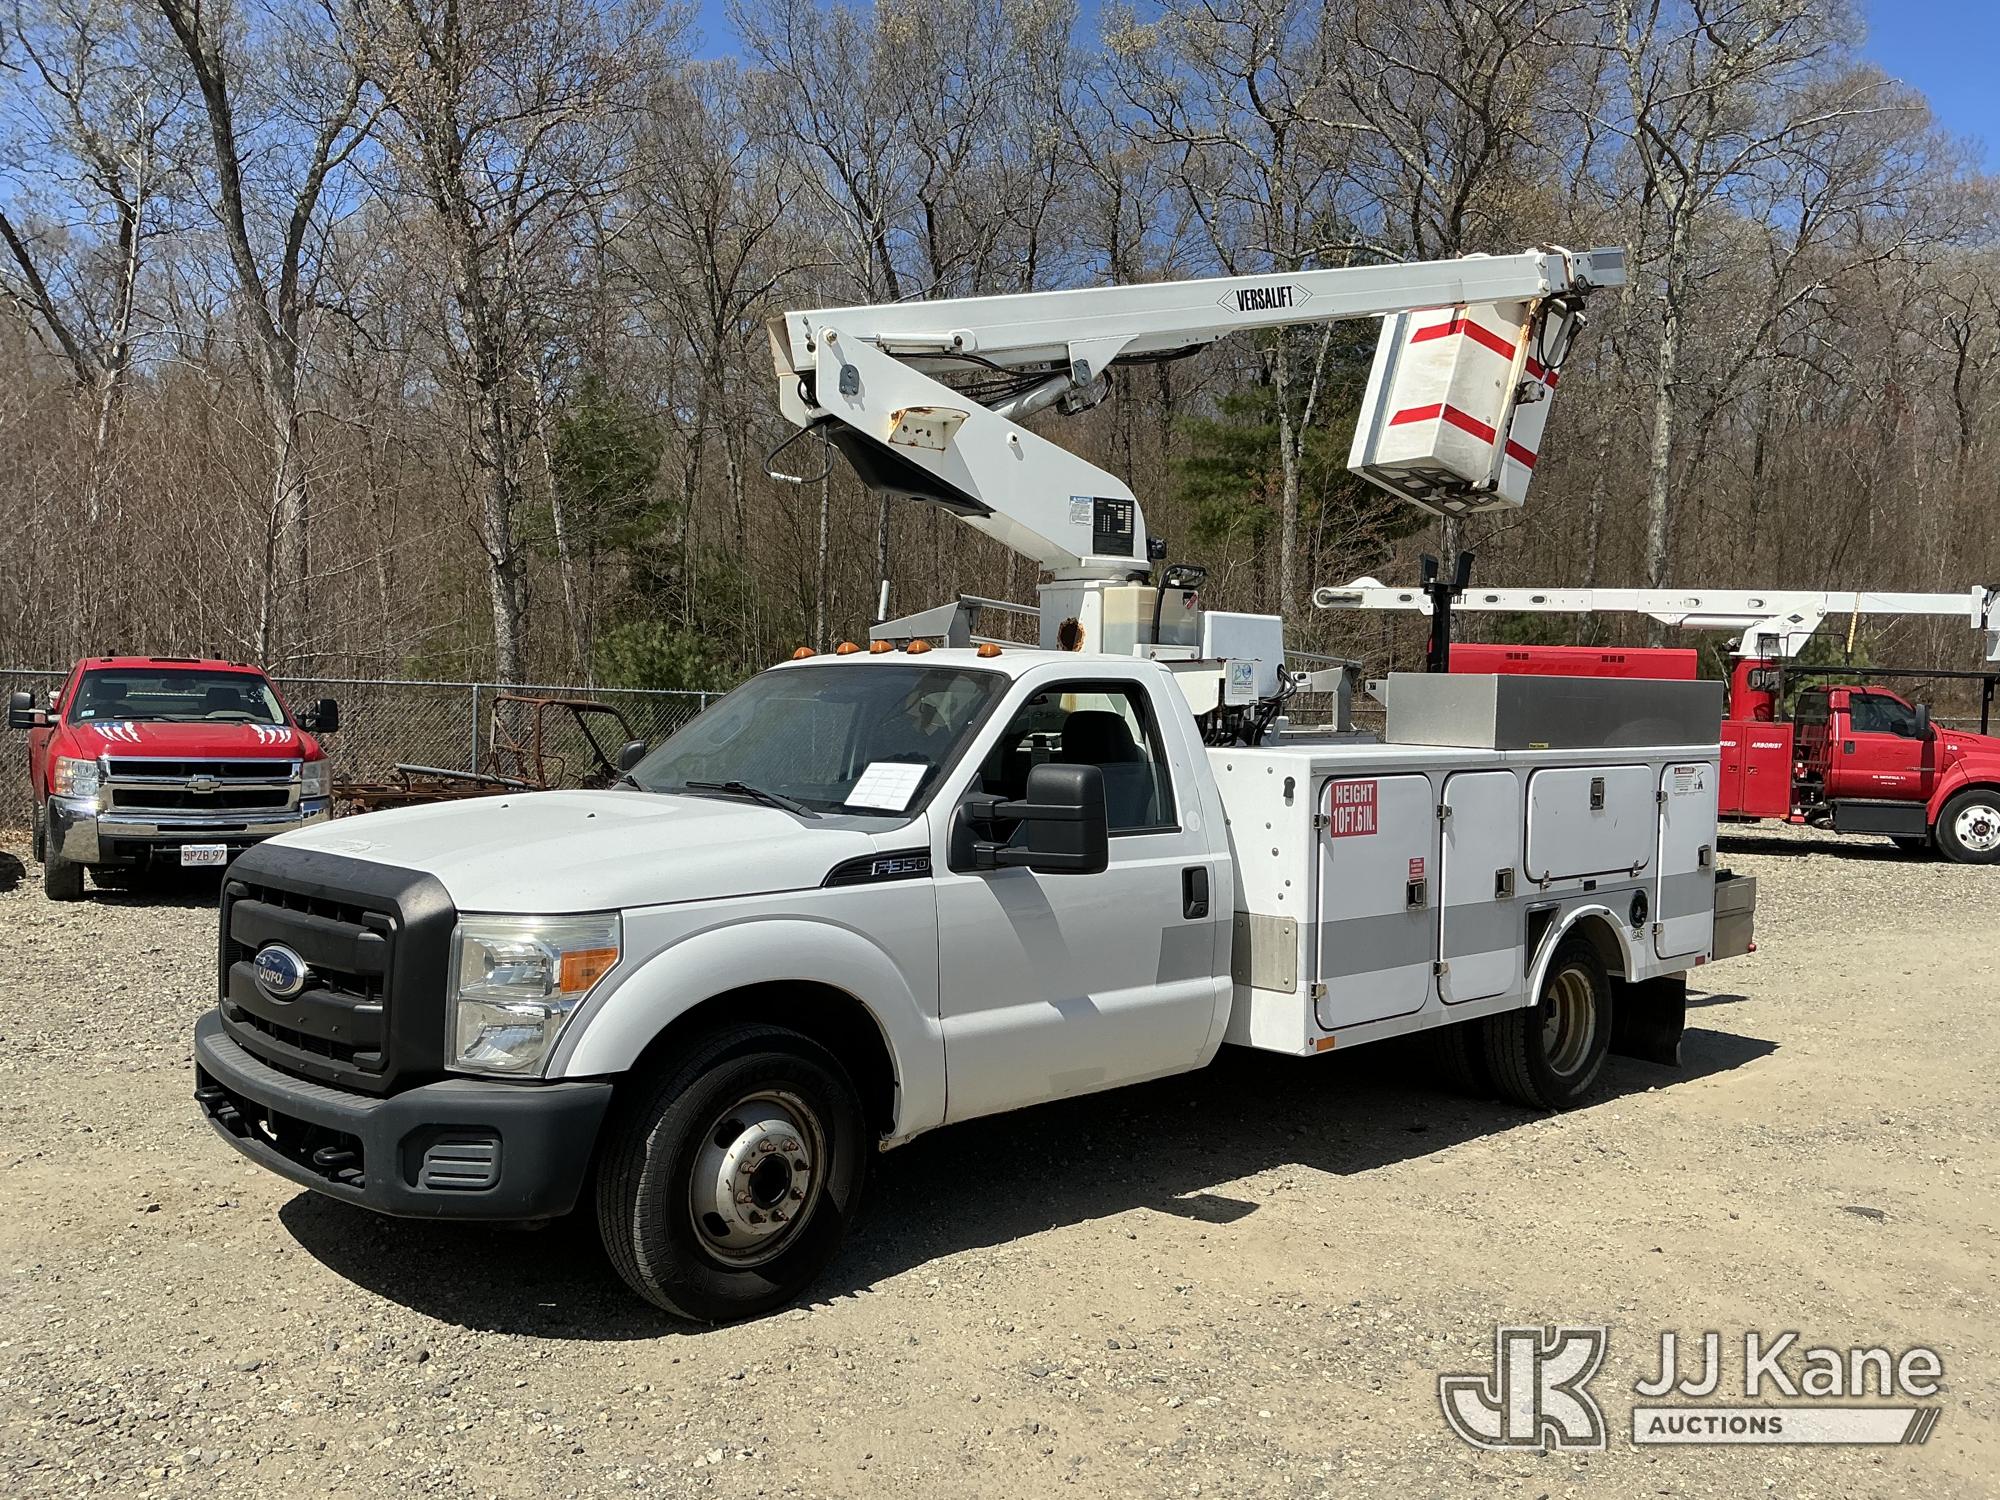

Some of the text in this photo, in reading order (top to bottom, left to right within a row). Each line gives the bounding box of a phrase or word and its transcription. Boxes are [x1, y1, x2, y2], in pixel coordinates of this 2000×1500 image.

[1236, 285, 1293, 312] VERSALIFT
[1451, 593, 1467, 605] LIFT
[1720, 740, 1736, 748] NSED
[1335, 783, 1374, 804] HEIGHT
[1632, 930, 1644, 939] GAS
